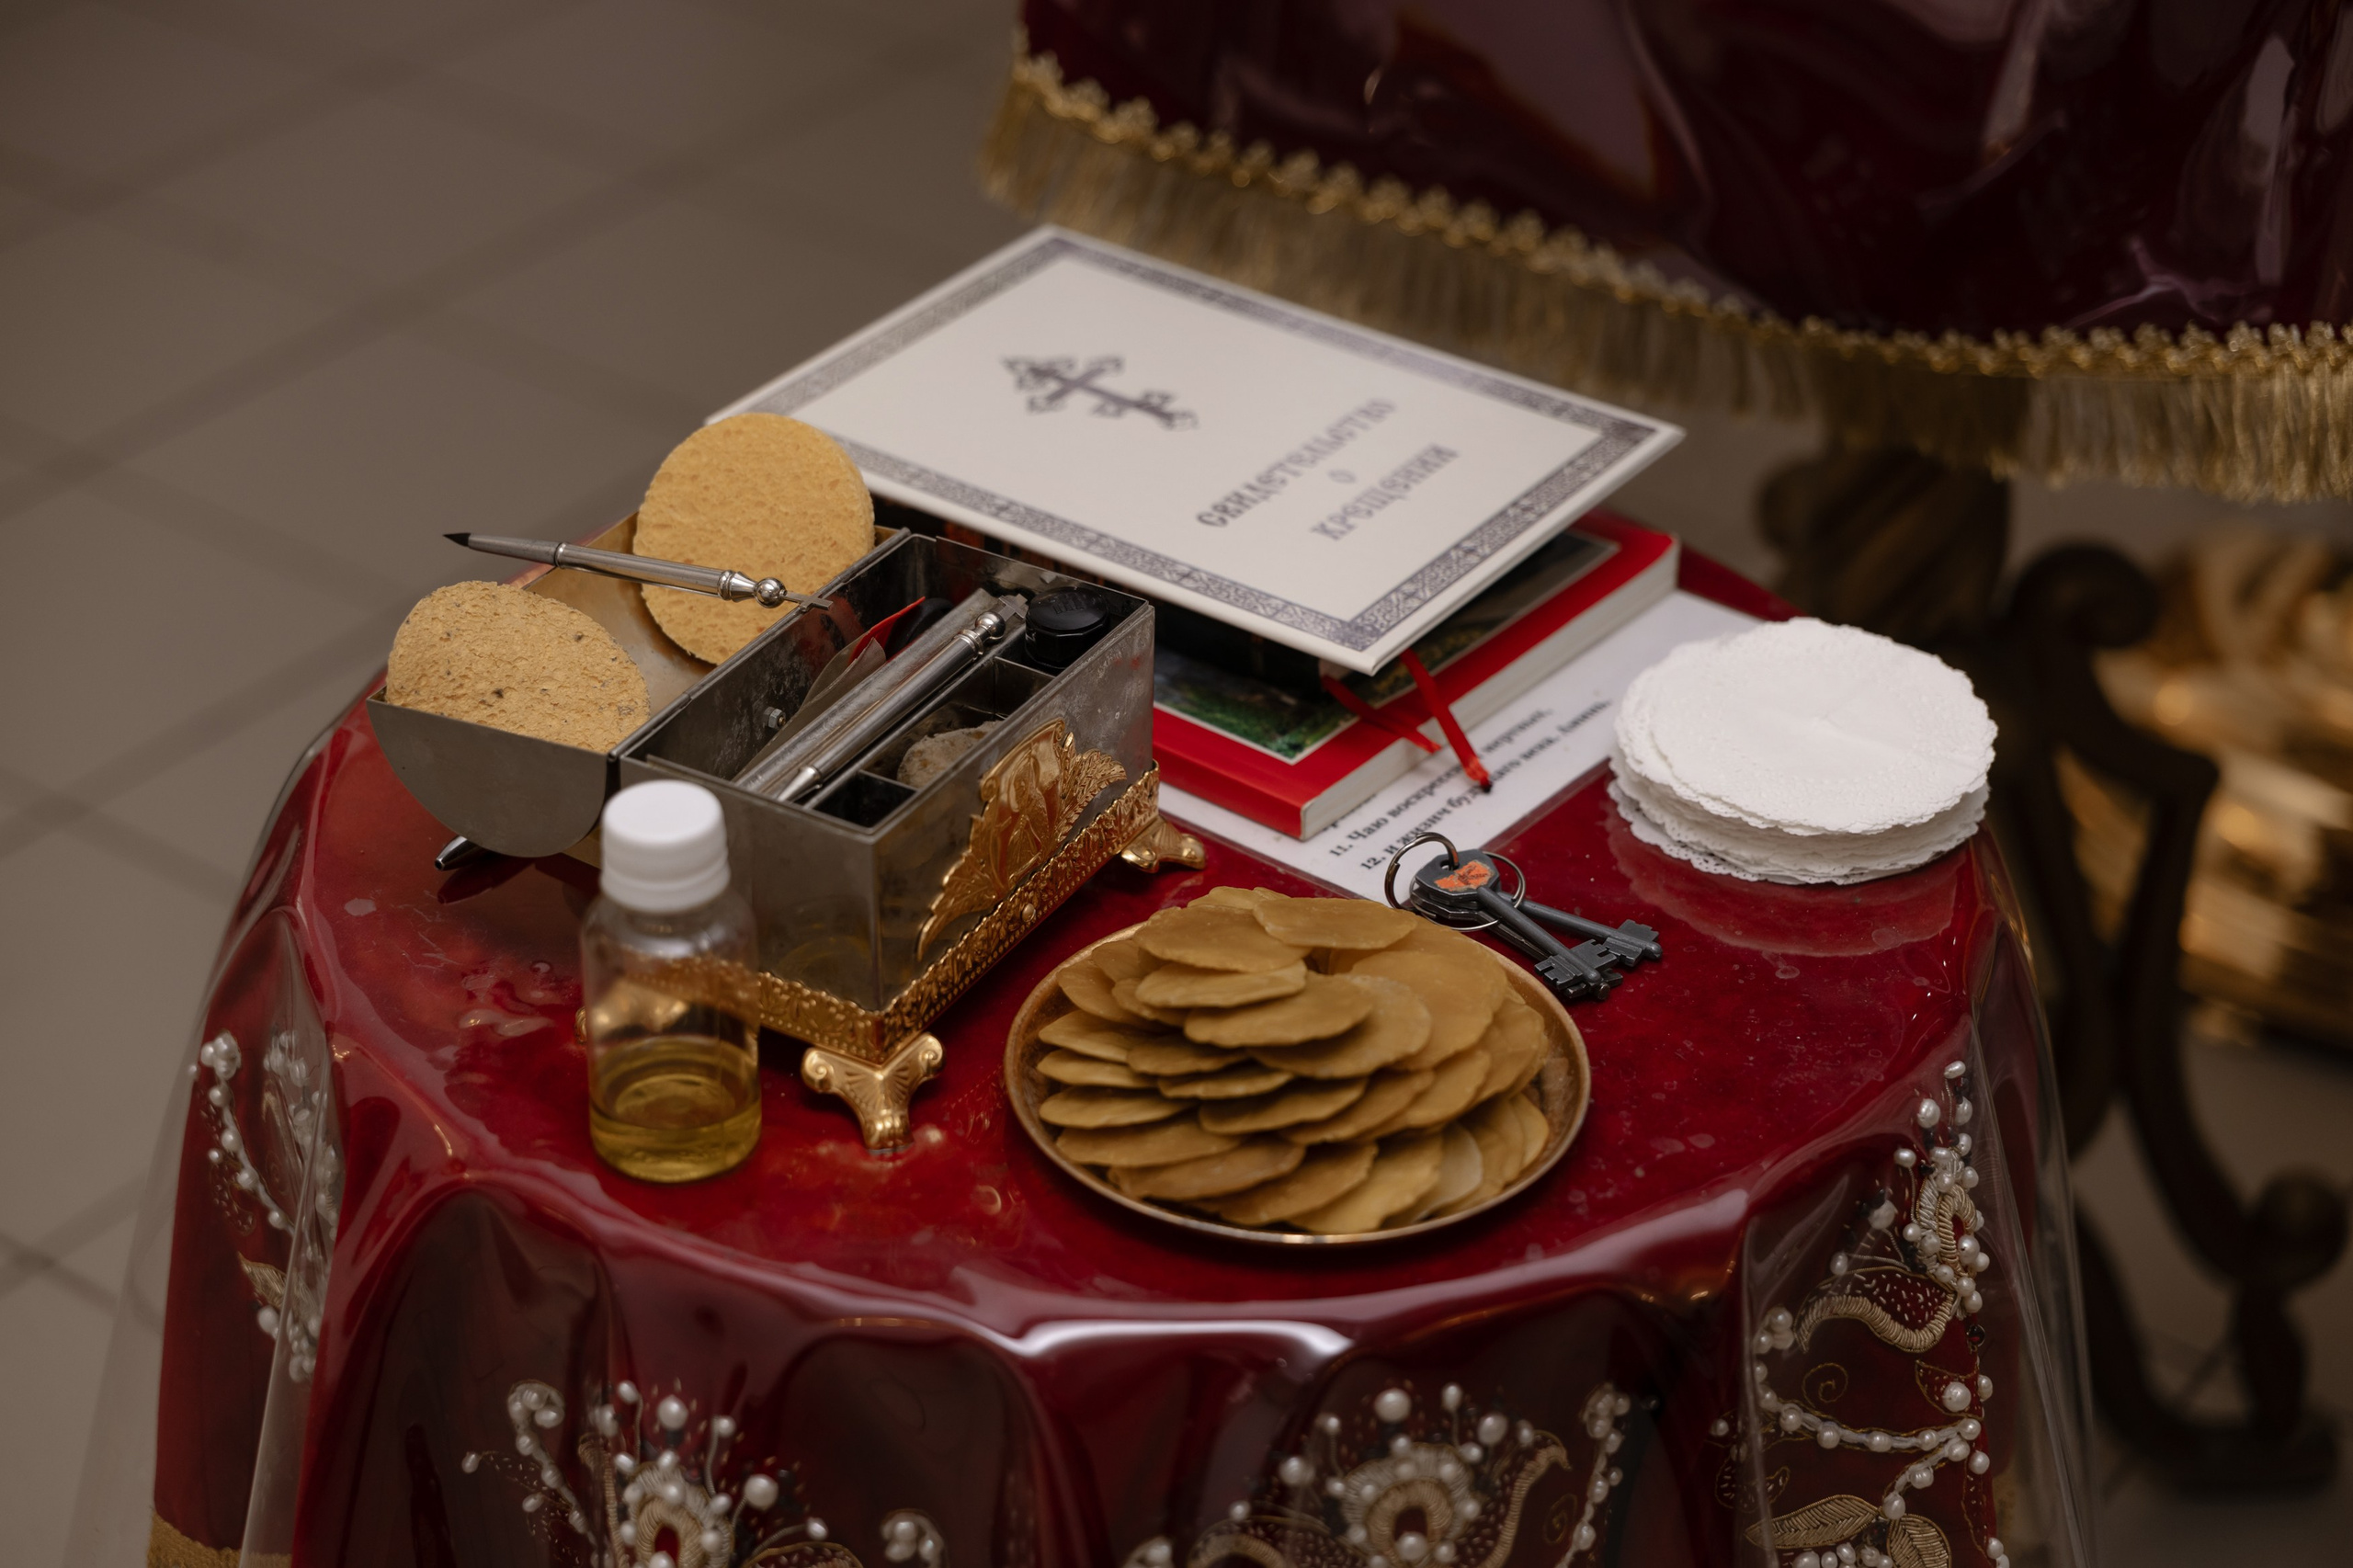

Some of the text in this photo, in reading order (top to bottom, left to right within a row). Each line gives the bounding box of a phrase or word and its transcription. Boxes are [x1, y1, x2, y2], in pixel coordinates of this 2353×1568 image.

[1329, 843, 1354, 858] 11.
[1347, 816, 1389, 841] Чаю
[1360, 855, 1387, 871] 12.
